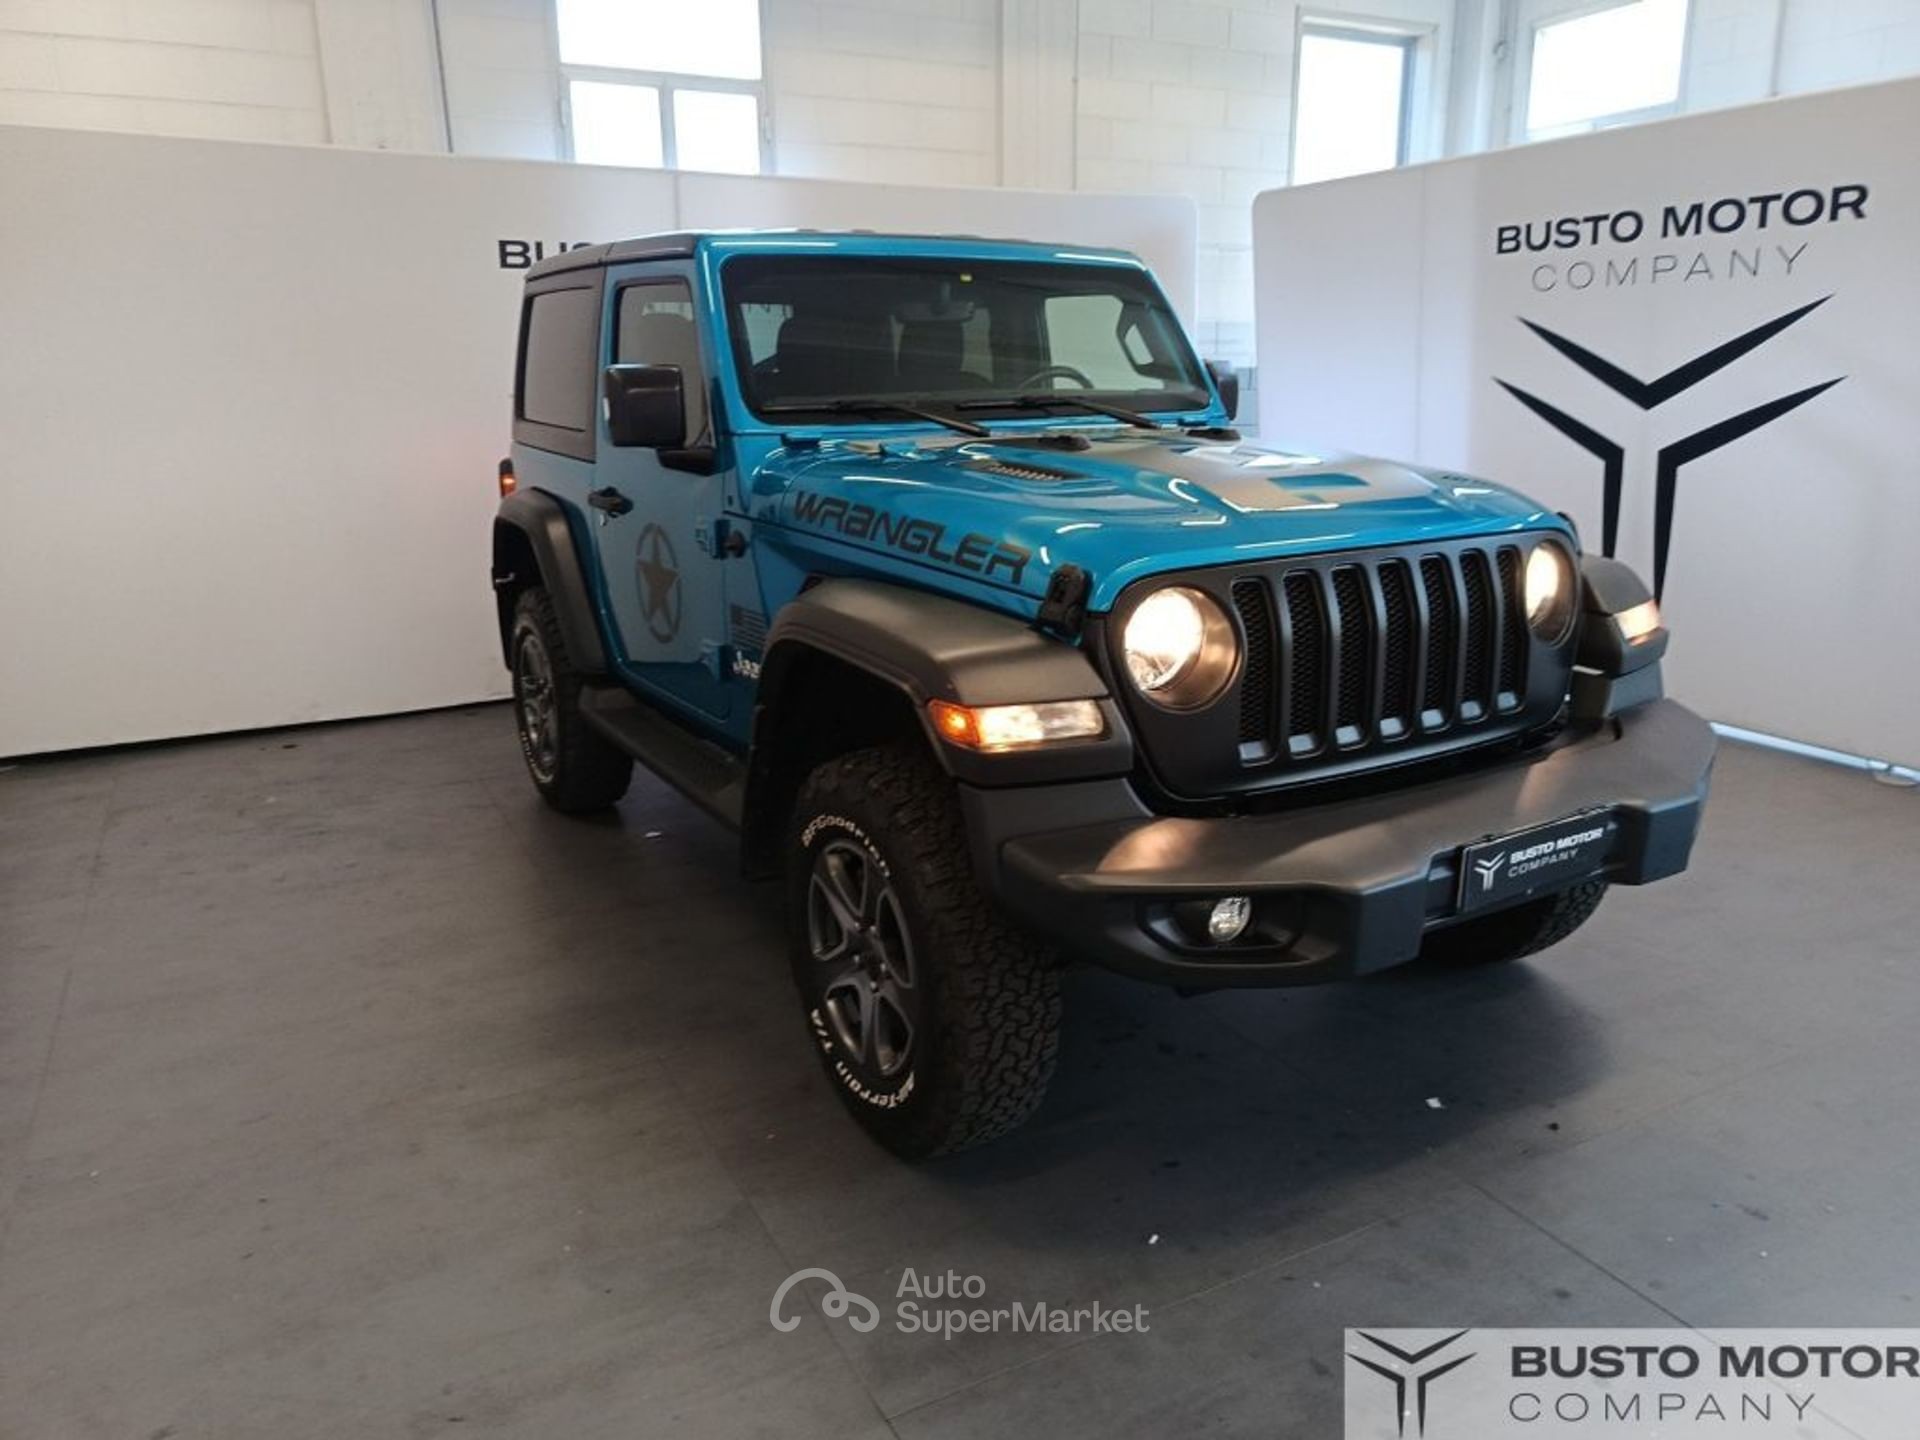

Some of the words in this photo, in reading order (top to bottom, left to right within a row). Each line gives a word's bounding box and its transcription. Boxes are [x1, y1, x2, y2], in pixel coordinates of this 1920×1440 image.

[1496, 210, 1643, 254] BUSTO
[1661, 184, 1869, 238] MOTOR
[1531, 243, 1808, 292] COMPANY
[1509, 850, 1579, 877] COMPANY
[1510, 841, 1555, 864] BUSTO
[1556, 828, 1604, 850] MOTOR
